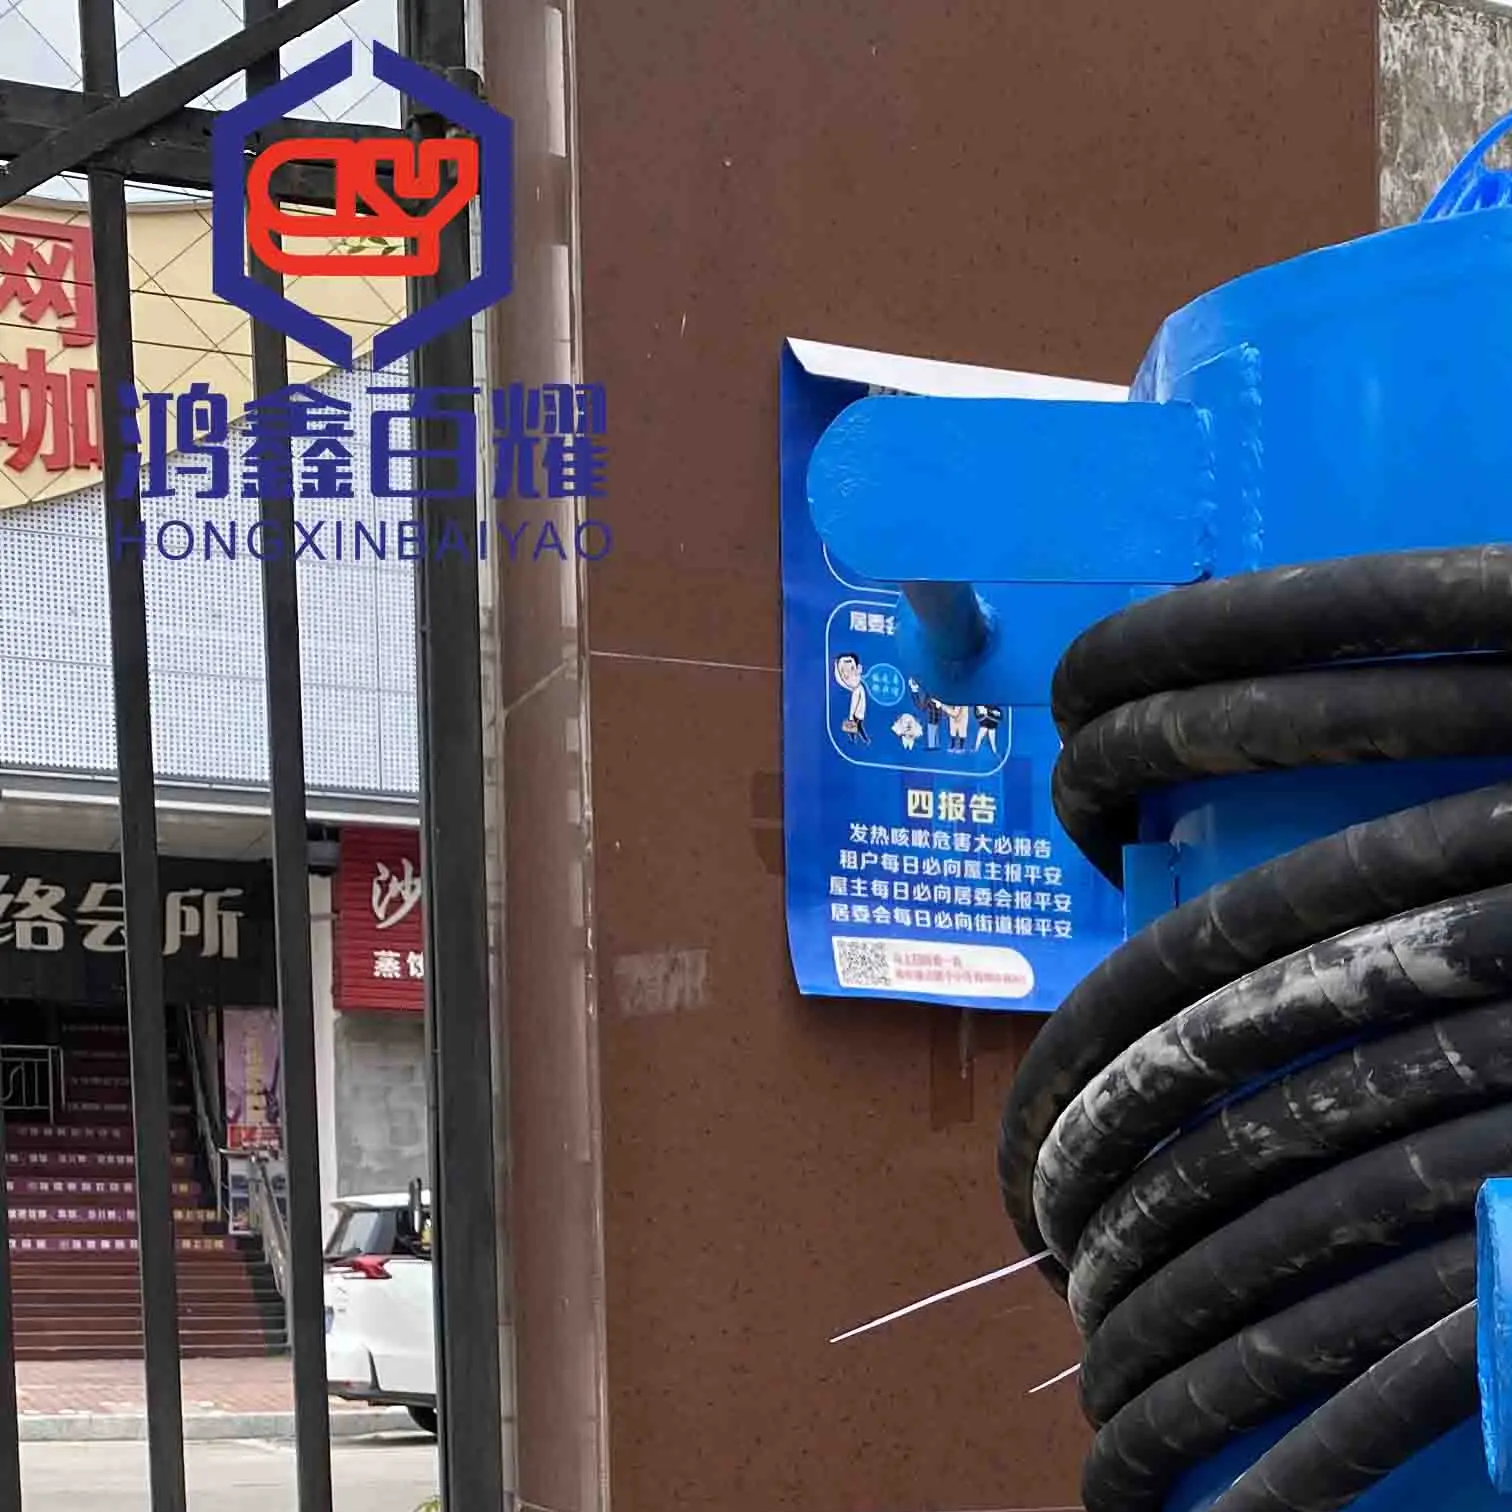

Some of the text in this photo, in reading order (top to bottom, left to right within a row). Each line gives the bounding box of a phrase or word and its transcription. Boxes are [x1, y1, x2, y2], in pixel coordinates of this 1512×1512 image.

[907, 788, 996, 824] 四报告
[849, 822, 1051, 859] 发热咳嗽危害大必报告
[839, 848, 1063, 887] 租户每日必向屋主报平安
[829, 875, 1072, 914] 屋主每日必向居委会报平安
[831, 902, 1073, 940] 居委会每日必向街道报平安
